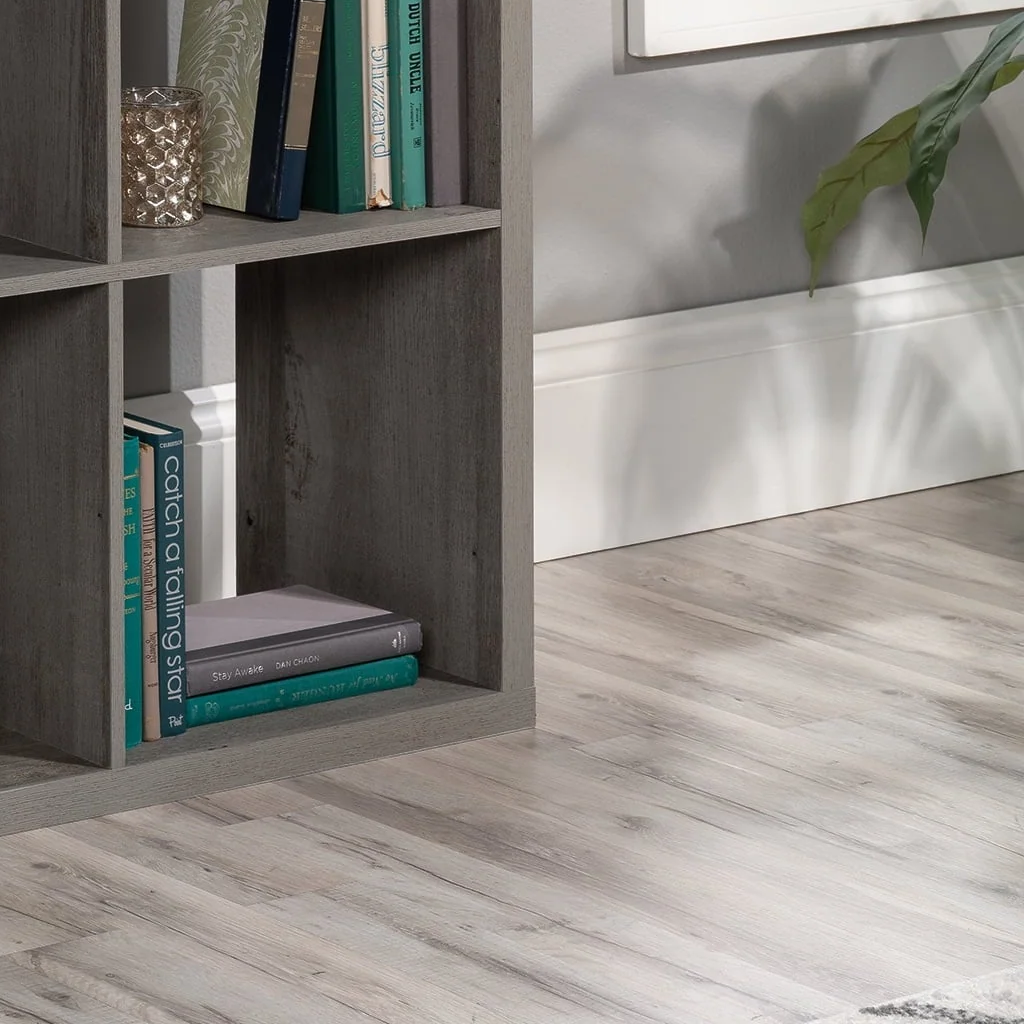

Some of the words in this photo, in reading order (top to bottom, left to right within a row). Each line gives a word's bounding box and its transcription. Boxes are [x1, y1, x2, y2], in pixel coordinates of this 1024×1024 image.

[408, 3, 421, 46] DUTCH
[409, 52, 422, 94] UNCLE
[164, 455, 184, 538] catch
[143, 538, 155, 549] for
[165, 543, 180, 561] a
[143, 559, 156, 589] Secular
[144, 589, 157, 611] World
[162, 567, 185, 650] falling
[211, 670, 233, 683] Stay
[234, 665, 264, 679] Awake
[275, 660, 292, 671] DAN
[293, 655, 320, 668] CHAON
[166, 655, 185, 704] star
